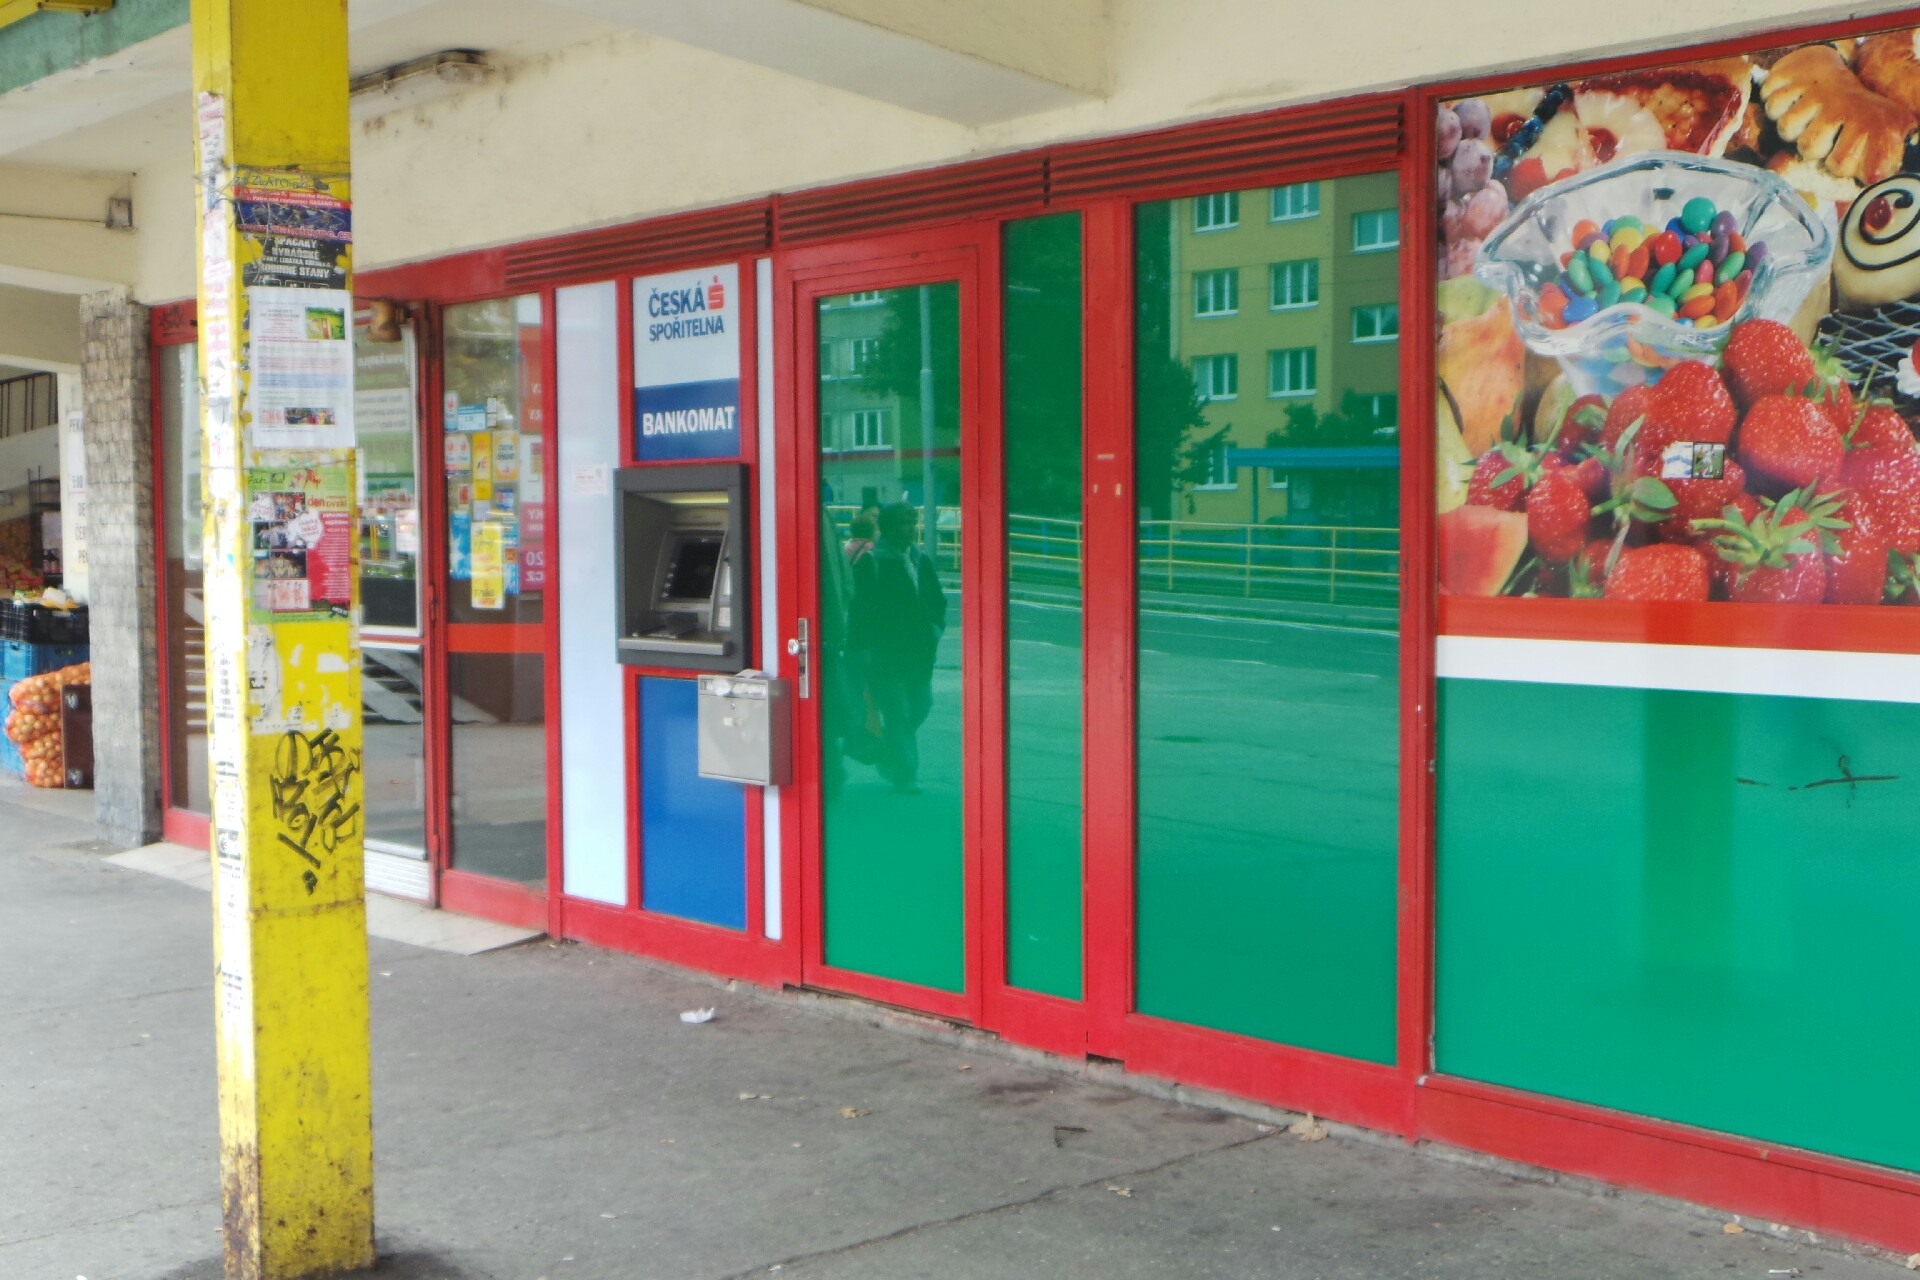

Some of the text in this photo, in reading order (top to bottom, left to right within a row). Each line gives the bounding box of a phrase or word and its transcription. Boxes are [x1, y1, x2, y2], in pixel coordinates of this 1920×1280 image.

[648, 280, 706, 318] ČESKÁ
[649, 314, 725, 342] SPOŘITELNA
[642, 405, 736, 436] BANKOMAT
